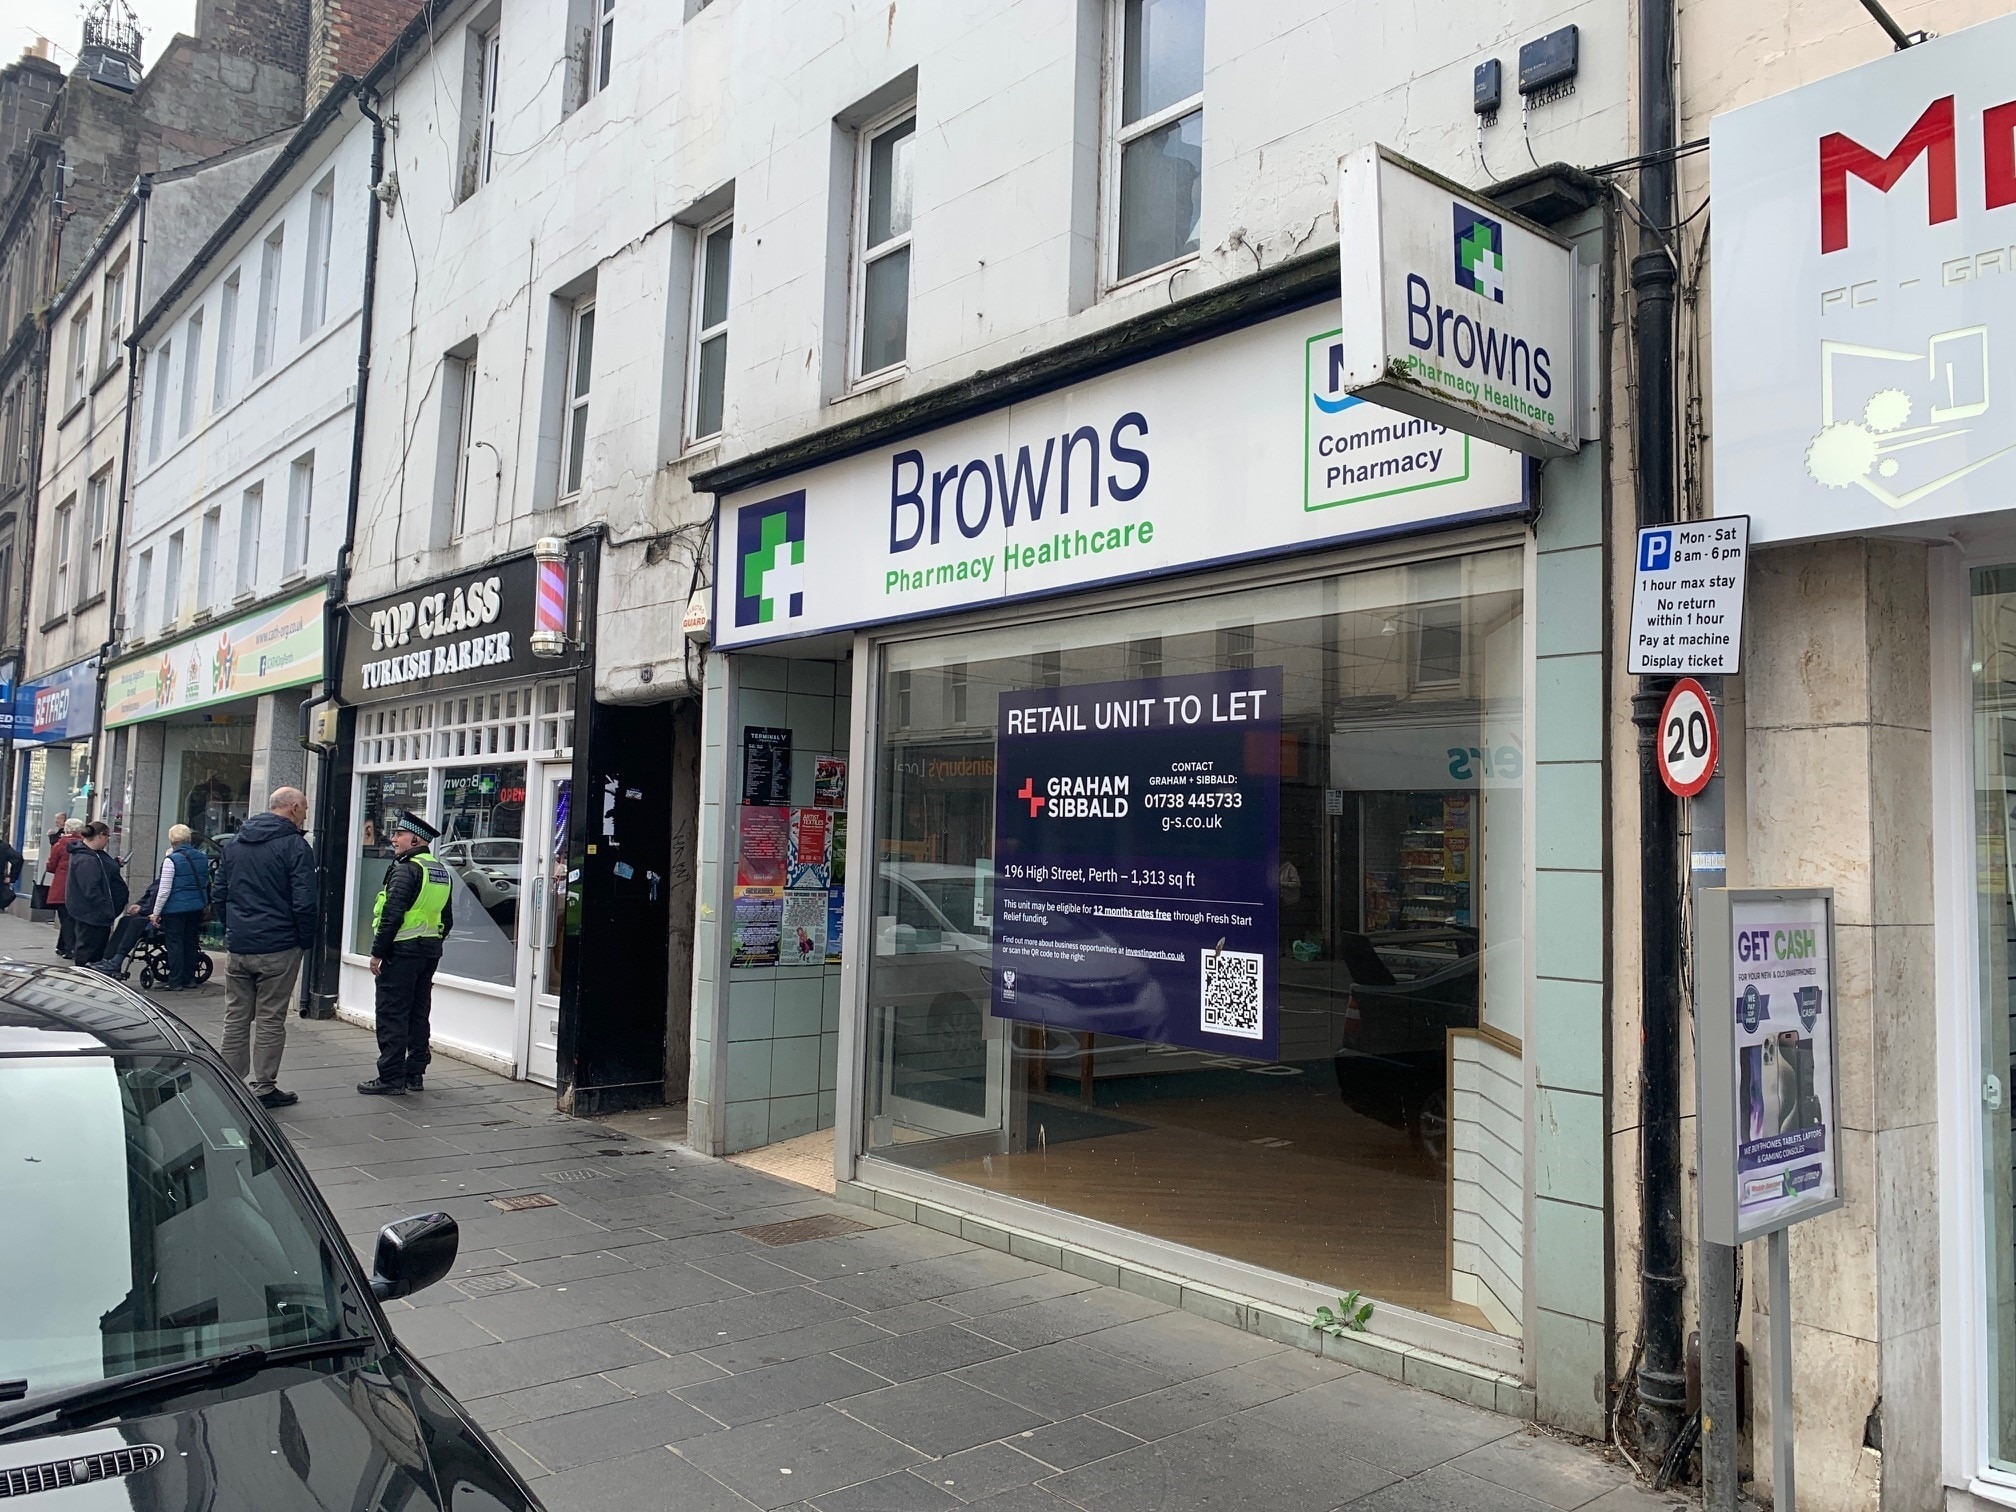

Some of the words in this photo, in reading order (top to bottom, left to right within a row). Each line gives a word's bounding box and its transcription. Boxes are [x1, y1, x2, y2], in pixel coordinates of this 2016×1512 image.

[1821, 279, 1878, 316] PC
[1407, 272, 1552, 399] Browns
[1408, 354, 1479, 400] Pharmacy
[1484, 383, 1555, 426] Healthcare
[1326, 448, 1443, 489] Pharmacy
[889, 410, 1150, 555] Browns
[1680, 532, 1705, 545] Mon
[1715, 528, 1737, 541] Sat
[885, 554, 995, 595] Pharmacy
[1004, 520, 1154, 572] Healthcare
[1648, 535, 1668, 567] P
[1674, 550, 1682, 563] 8
[1684, 552, 1703, 562] am
[1711, 547, 1719, 560] 6
[1721, 548, 1741, 561] pm
[1642, 580, 1647, 591] 1
[1650, 579, 1677, 591] hour
[1680, 578, 1705, 589] max
[1709, 576, 1736, 591] stay
[370, 601, 416, 651] TOP
[418, 576, 501, 640] CLASS
[1657, 599, 1674, 611] No
[1677, 598, 1716, 610] return
[683, 617, 706, 628] GUARD
[1647, 614, 1683, 627] within
[1687, 614, 1692, 625] 1
[1696, 613, 1724, 625] hour
[1639, 634, 1660, 649] Pay
[1663, 635, 1675, 646] at
[1678, 633, 1730, 646] machine
[361, 649, 432, 690] TURKISH
[433, 631, 511, 675] BARBER
[1641, 654, 1684, 669] Display
[1687, 654, 1724, 667] ticket
[35, 688, 70, 727] BETFRED
[1008, 704, 1086, 735] RETAIL
[1094, 698, 1155, 730] UNIT
[1163, 695, 1202, 725] TO
[1212, 690, 1267, 723] LET
[1667, 710, 1708, 763] 20
[1171, 761, 1214, 772] CONTACT
[1047, 775, 1129, 797] GRAHAM
[1149, 776, 1187, 786] GRAHAM
[1196, 774, 1238, 785] SIBBALD:
[500, 787, 526, 803] OPEN
[1144, 794, 1184, 809] 01738
[1188, 793, 1242, 808] 445733
[1047, 798, 1129, 818] SIBBALD
[1162, 814, 1223, 831] g-s.co.uk
[1004, 864, 1024, 878] 196
[1026, 865, 1049, 882] High
[1051, 866, 1086, 883] Street,
[1088, 867, 1118, 882] Perth
[1131, 869, 1165, 886] 1,313
[1168, 873, 1183, 889] sq
[1186, 871, 1196, 887] ft
[1003, 899, 1017, 909] This
[1018, 900, 1031, 910] unit
[1031, 902, 1046, 913] may
[1046, 901, 1056, 912] be
[1056, 902, 1081, 914] eligible
[1082, 904, 1092, 914] for
[1093, 905, 1103, 915] 12
[1104, 906, 1133, 917] months
[1134, 909, 1154, 919] rates
[1155, 909, 1172, 920] free
[1173, 910, 1204, 924] through
[1206, 912, 1229, 924] Fresh
[1231, 914, 1252, 926] Start
[1003, 911, 1021, 921] Relief
[1022, 913, 1049, 926] funding.
[1002, 935, 1014, 944] Find
[1014, 937, 1024, 945] out
[1024, 938, 1038, 946] more
[1038, 938, 1054, 948] about
[1054, 939, 1079, 950] business
[1079, 942, 1117, 955] opportunities
[1117, 945, 1125, 955] at
[1125, 947, 1185, 962] investinperth.co.uk
[1008, 946, 1021, 954] scan
[1021, 946, 1030, 955] the
[1030, 948, 1039, 957] QR
[1039, 948, 1053, 958] code
[1053, 950, 1060, 959] to
[1060, 951, 1070, 960] the
[1070, 952, 1086, 963] right:
[1738, 930, 1770, 962] GET
[1774, 929, 1817, 960] CASH
[1738, 972, 1747, 981] FOR
[1748, 972, 1761, 981] YOUR
[1760, 971, 1771, 980] NEW
[1777, 970, 1786, 978] OLD
[1747, 994, 1756, 1002] WE
[1801, 1009, 1816, 1018] CASH
[1743, 1145, 1752, 1155] WE
[1751, 1144, 1759, 1154] BUY
[1802, 1129, 1822, 1141] LAPTOPS
[1761, 1151, 1783, 1163] GAMING
[1782, 1145, 1805, 1158] CONSOLES
